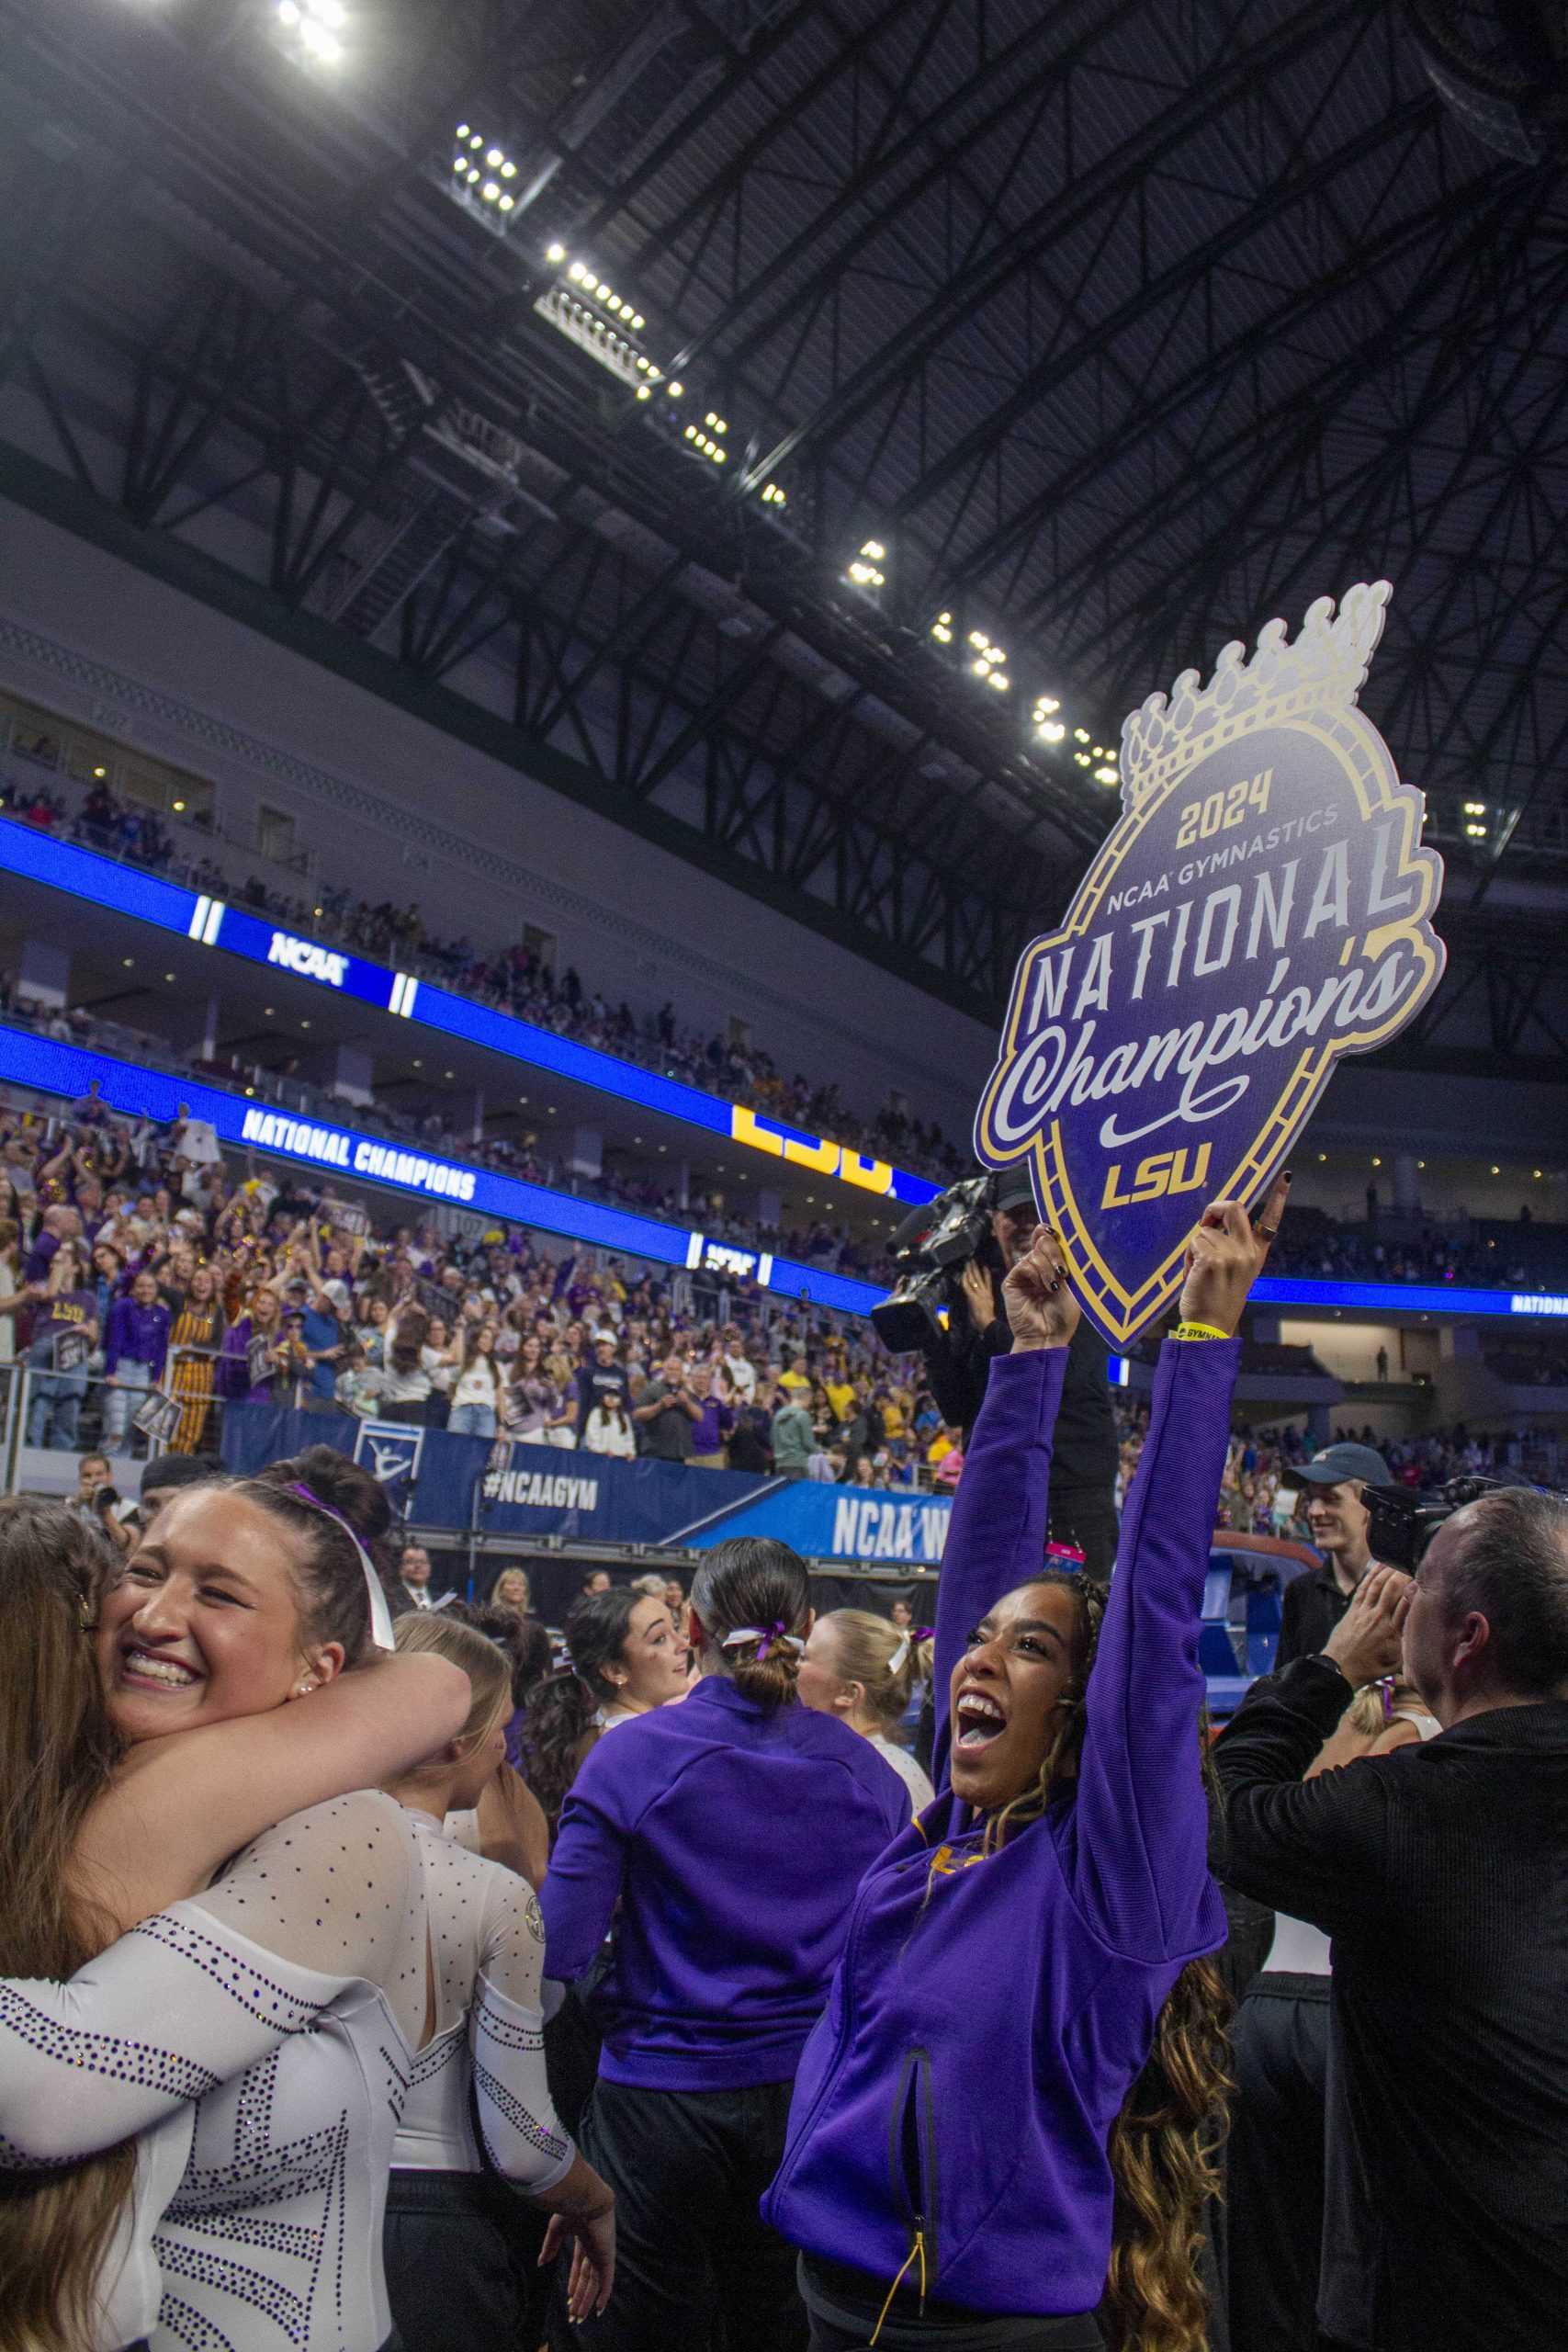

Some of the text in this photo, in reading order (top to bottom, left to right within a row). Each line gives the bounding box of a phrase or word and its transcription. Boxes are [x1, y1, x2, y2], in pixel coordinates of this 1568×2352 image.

[1175, 767, 1274, 850] 2024
[1107, 803, 1338, 915] NCAA GYMNASTICS
[267, 932, 345, 987] NCAA
[1027, 822, 1414, 1035] NATIONAL
[994, 951, 1415, 1148] Champions
[242, 1109, 477, 1201] NATIONAL CHAMPIONS
[1100, 1142, 1213, 1210] LSU
[482, 1471, 599, 1511] #NCAAGYM
[832, 1497, 914, 1559] NCAA
